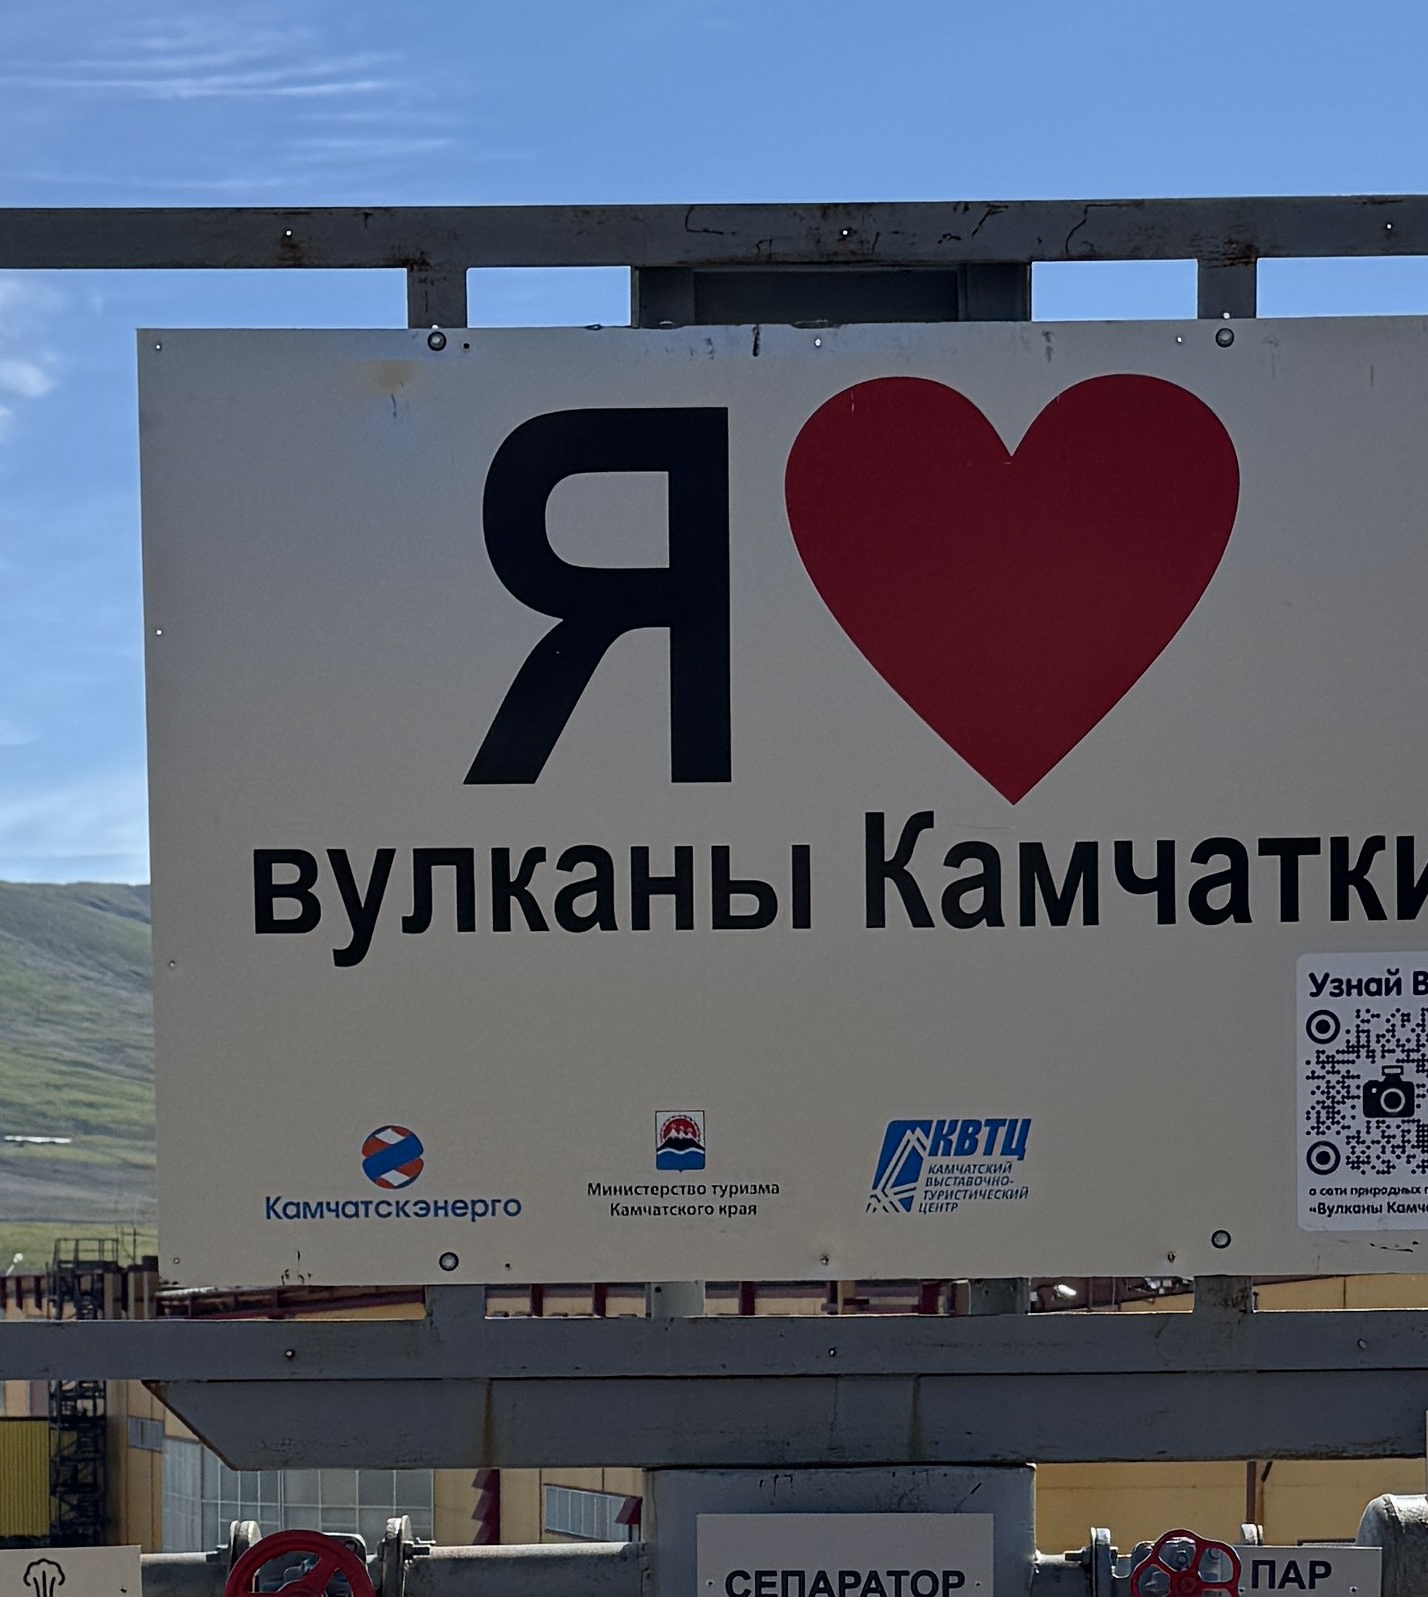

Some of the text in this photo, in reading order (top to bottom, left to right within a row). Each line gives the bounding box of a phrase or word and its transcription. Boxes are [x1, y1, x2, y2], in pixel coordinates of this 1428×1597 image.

[460, 404, 734, 786] Я
[253, 844, 812, 968] вулканы
[1307, 967, 1403, 998] Узнай
[927, 1117, 1033, 1161] КВТЦ
[927, 1161, 1013, 1175] КАМЧАТСКИЙ
[586, 1181, 781, 1199] Министерство туризма
[924, 1175, 1015, 1188] ВЫСТАВОЧНО-
[922, 1186, 1030, 1201] ТУРИСТИЧЕСКИЙ
[1308, 1187, 1317, 1197] о
[263, 1193, 523, 1222] Камчатскэнерго
[609, 1202, 758, 1218] Камчатского края
[918, 1201, 959, 1215] ЦЕНТР
[1308, 1201, 1383, 1218] «Вулканы
[1251, 1559, 1333, 1590] ПАР
